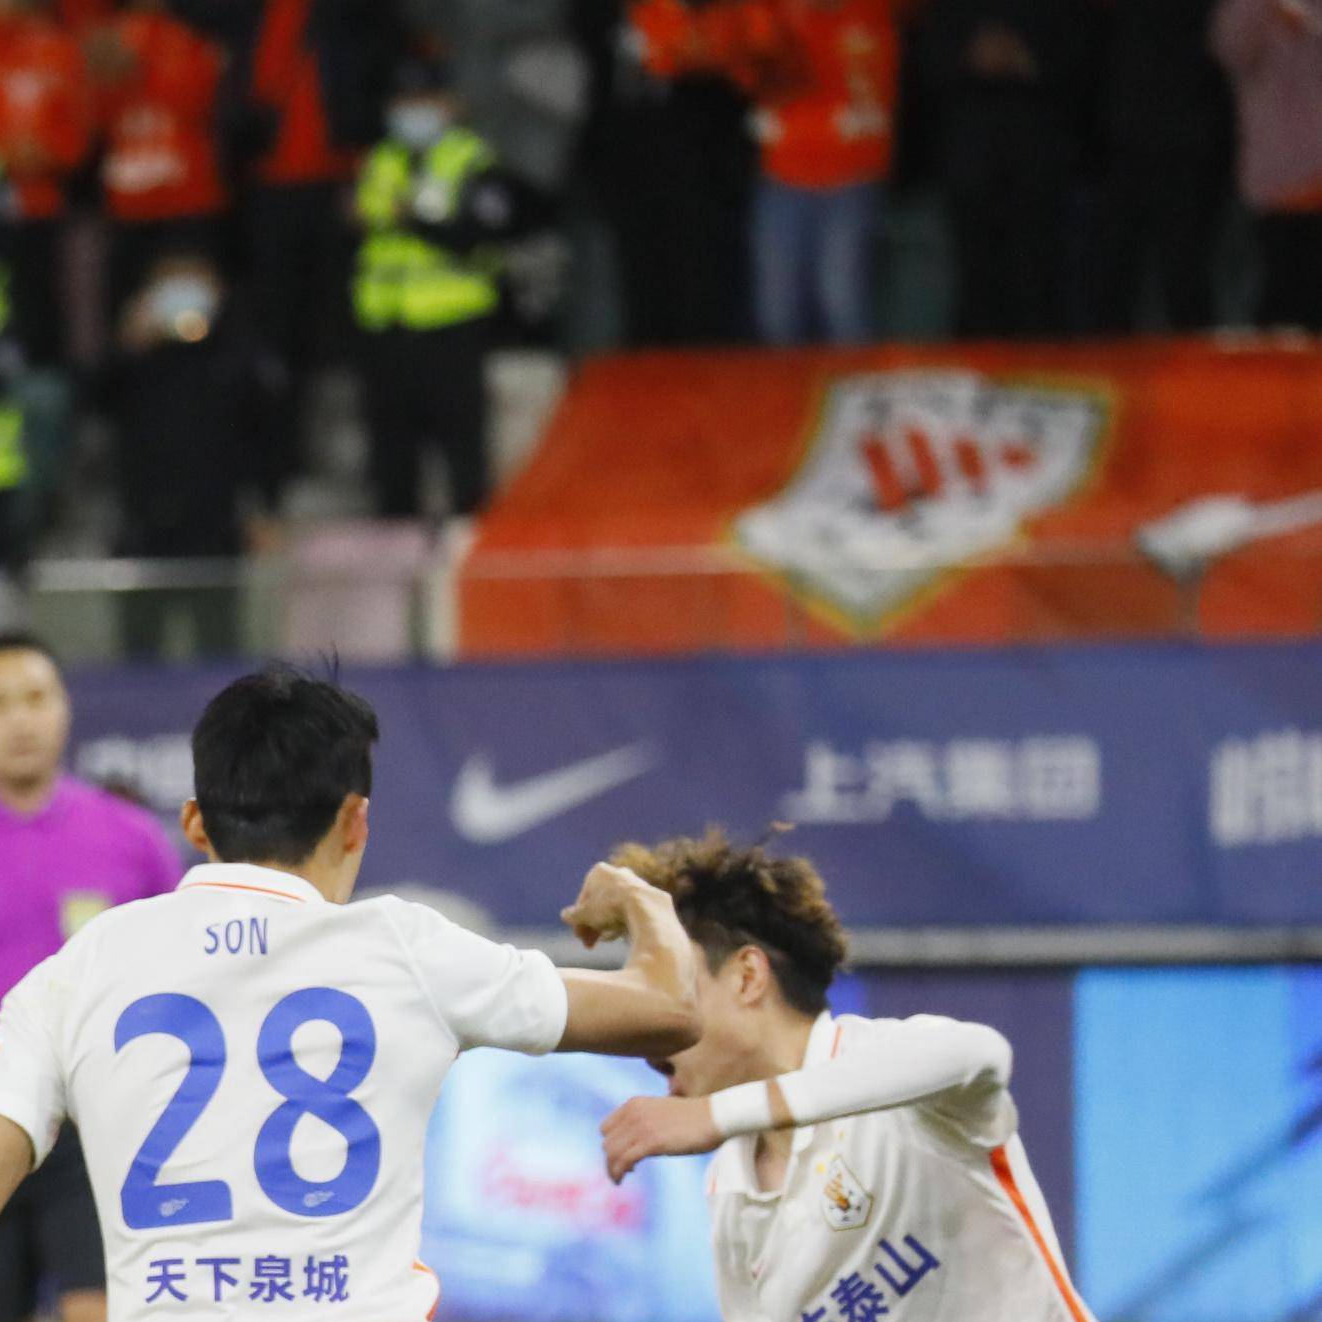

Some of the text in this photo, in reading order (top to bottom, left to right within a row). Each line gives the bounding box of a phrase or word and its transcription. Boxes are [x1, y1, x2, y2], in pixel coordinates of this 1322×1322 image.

[203, 917, 269, 955] SON
[114, 987, 381, 1230] 28
[146, 1255, 350, 1302] 天下泉城
